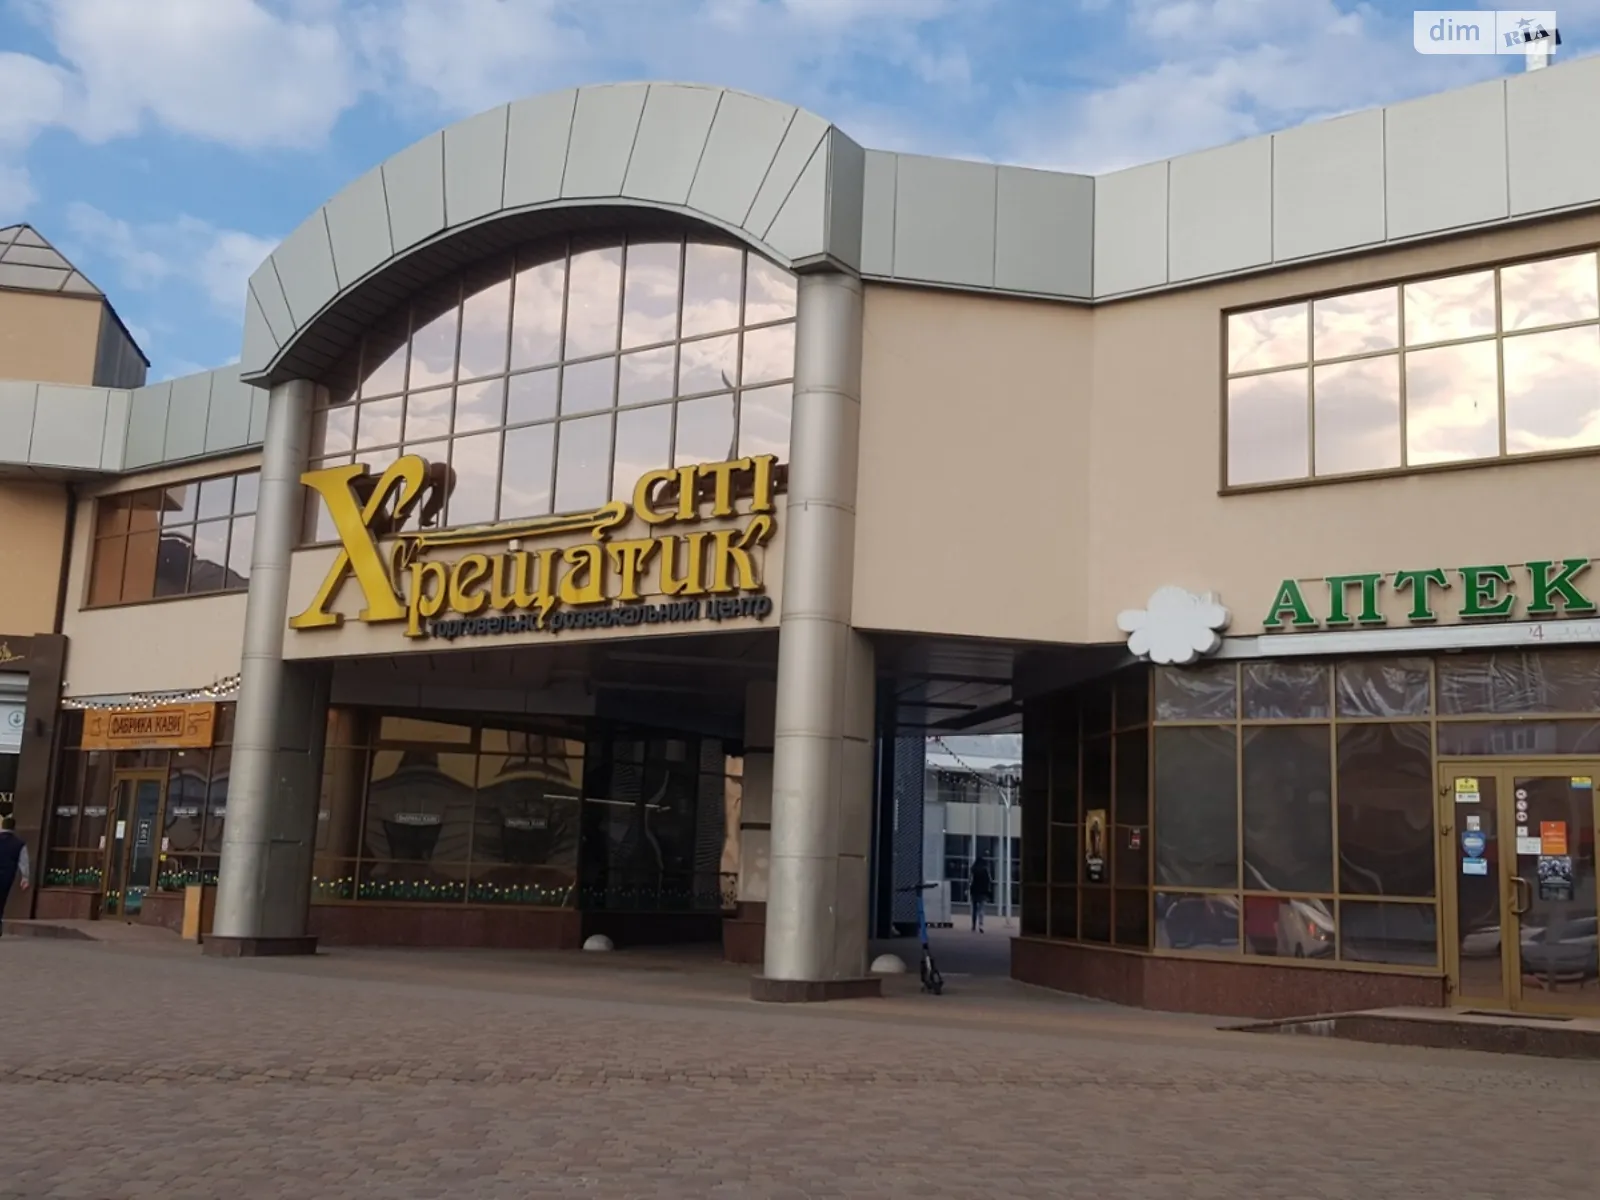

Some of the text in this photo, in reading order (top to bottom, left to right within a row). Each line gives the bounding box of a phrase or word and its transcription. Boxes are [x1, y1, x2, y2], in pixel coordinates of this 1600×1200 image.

[288, 453, 775, 638] Хрещатик
[705, 595, 774, 622] центр
[1262, 557, 1597, 629] АПТЕК
[111, 715, 182, 735] ФАБРИКА КАВИ
